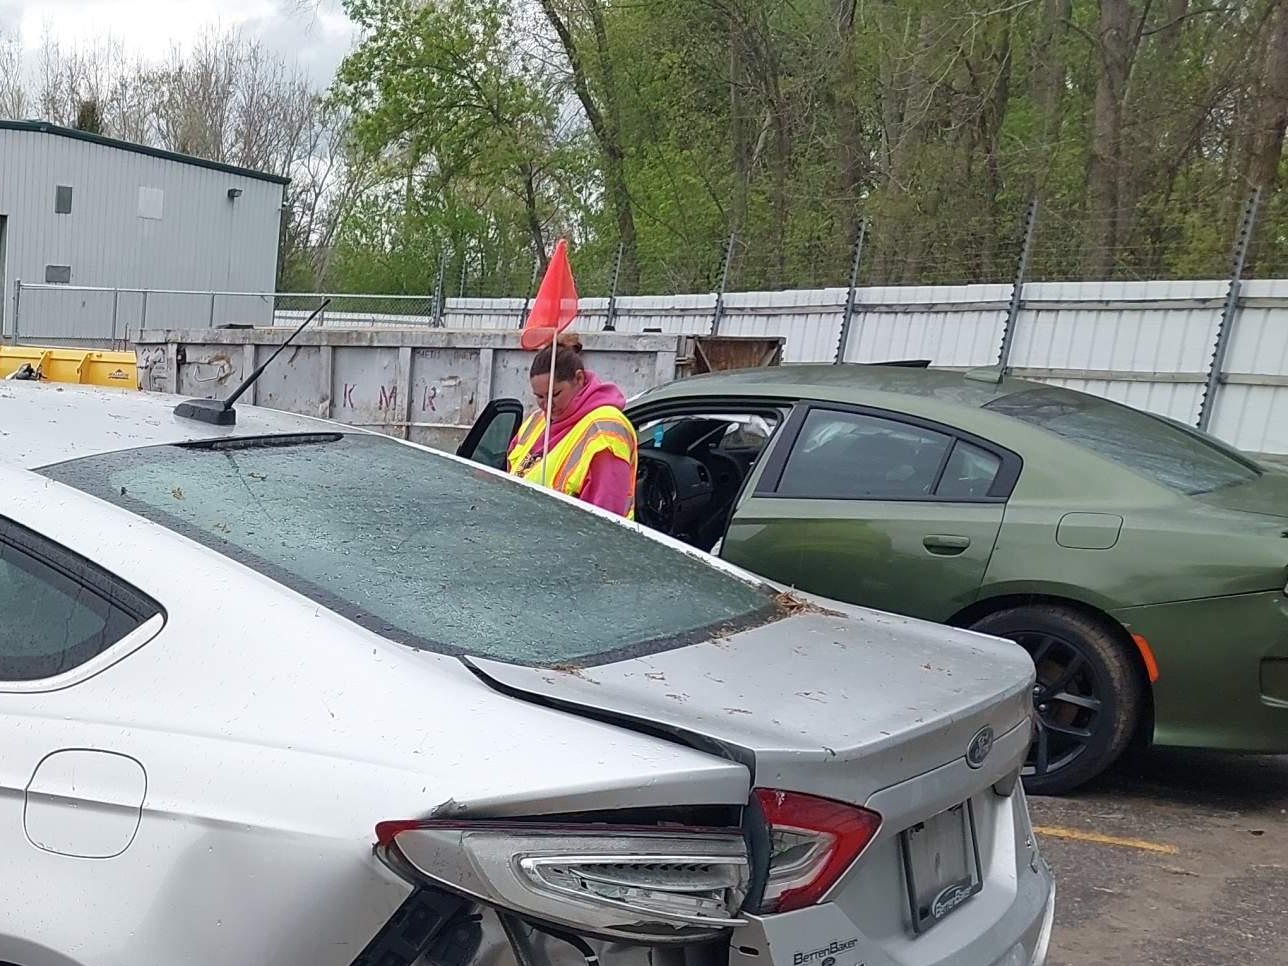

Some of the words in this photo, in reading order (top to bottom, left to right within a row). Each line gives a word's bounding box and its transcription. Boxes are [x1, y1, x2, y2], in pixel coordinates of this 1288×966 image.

[343, 383, 357, 409] K
[378, 385, 398, 411] M
[421, 385, 437, 412] R
